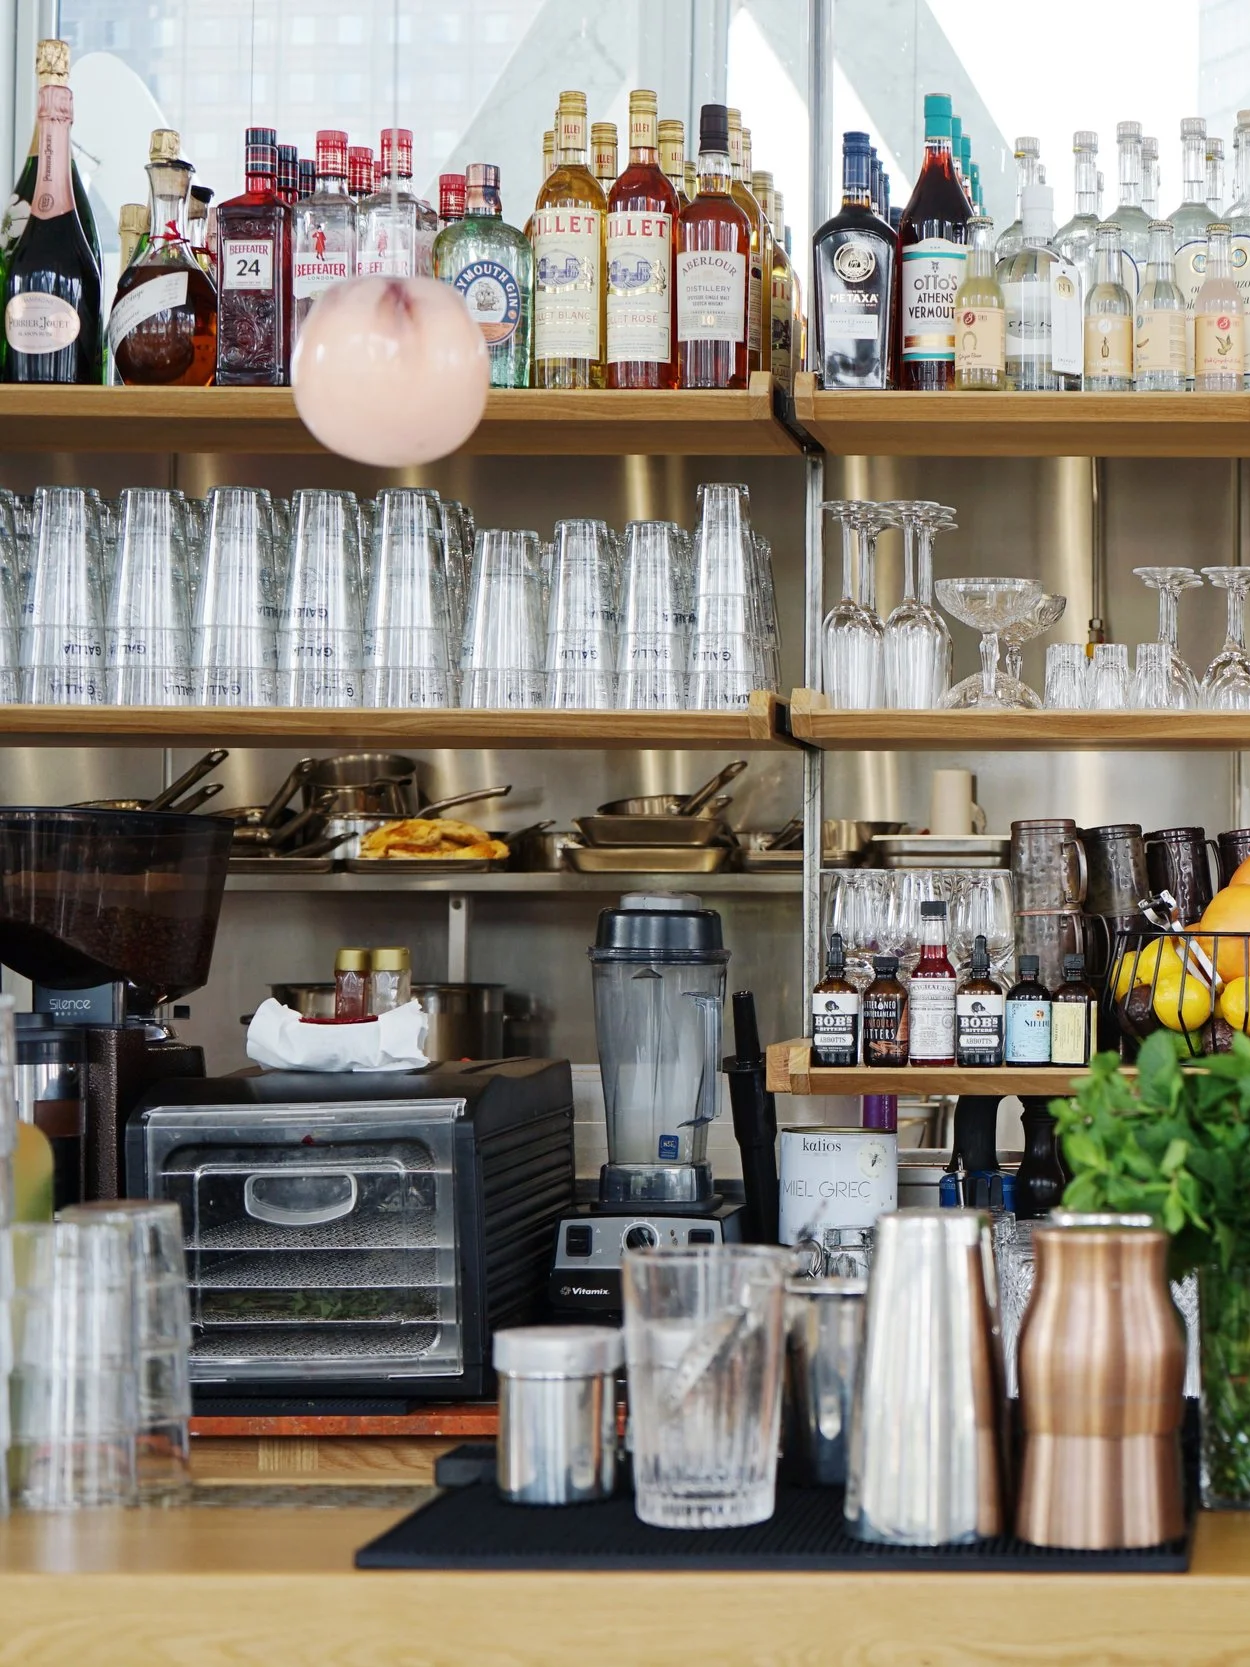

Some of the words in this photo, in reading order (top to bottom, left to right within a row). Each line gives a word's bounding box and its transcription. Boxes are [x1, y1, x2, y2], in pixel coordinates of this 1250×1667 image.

[536, 216, 594, 236] ILLET
[608, 220, 666, 238] ILLET
[230, 244, 268, 256] BEEFEATER
[236, 260, 260, 276] 24
[294, 262, 346, 278] BEEFEATER
[682, 256, 737, 277] ABERLOUR
[457, 264, 509, 295] YMOUTH
[506, 282, 518, 308] GIN
[830, 294, 878, 303] METAXA
[918, 293, 954, 304] ATHENS
[558, 310, 590, 321] BLANC
[908, 306, 955, 319] VERMOUT
[632, 314, 658, 324] ROSÉ
[49, 998, 92, 1010] Silence
[820, 1036, 846, 1044] ABBOTTS
[782, 1180, 813, 1198] MIEL
[818, 1180, 872, 1198] GREC
[572, 1286, 610, 1296] Vitamix
